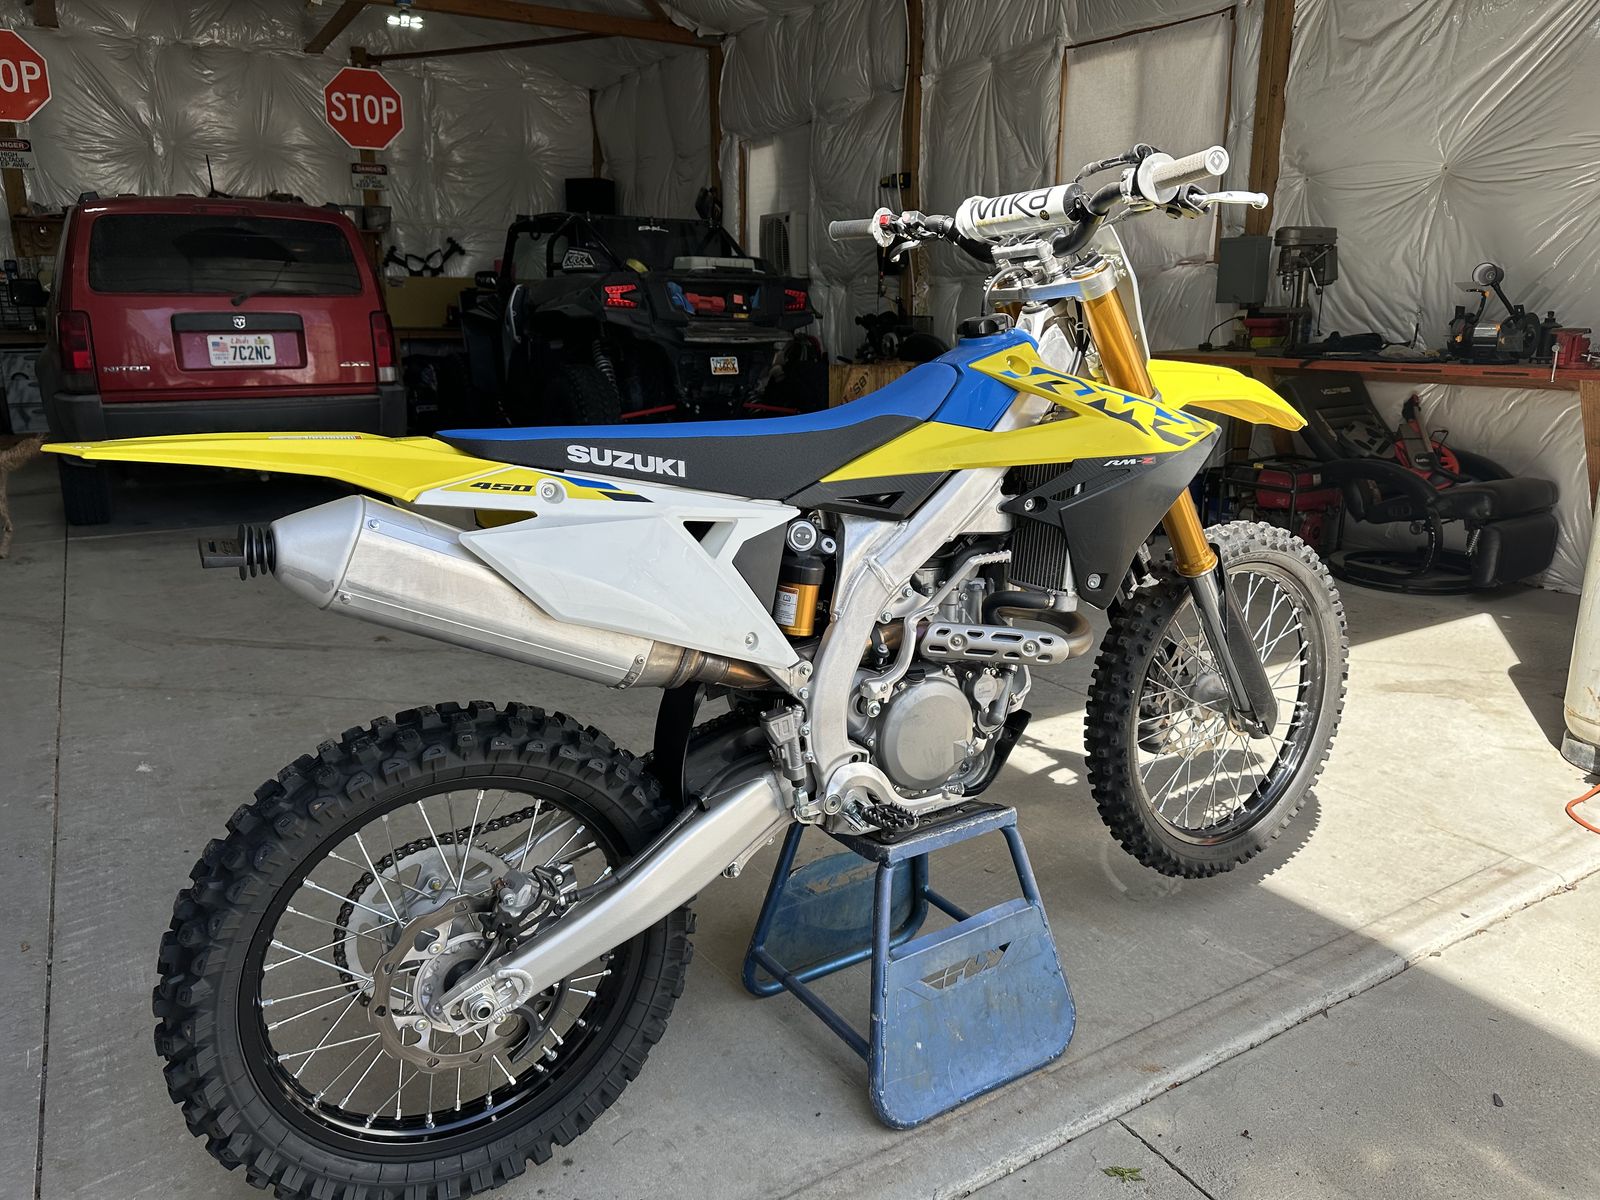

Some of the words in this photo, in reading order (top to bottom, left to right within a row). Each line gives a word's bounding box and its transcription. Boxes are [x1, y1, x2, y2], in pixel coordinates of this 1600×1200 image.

[330, 91, 398, 125] STOP
[230, 345, 271, 360] 7C2NC
[566, 444, 686, 478] SUZUKI
[1103, 456, 1156, 467] RM-Z
[470, 482, 533, 492] 450
